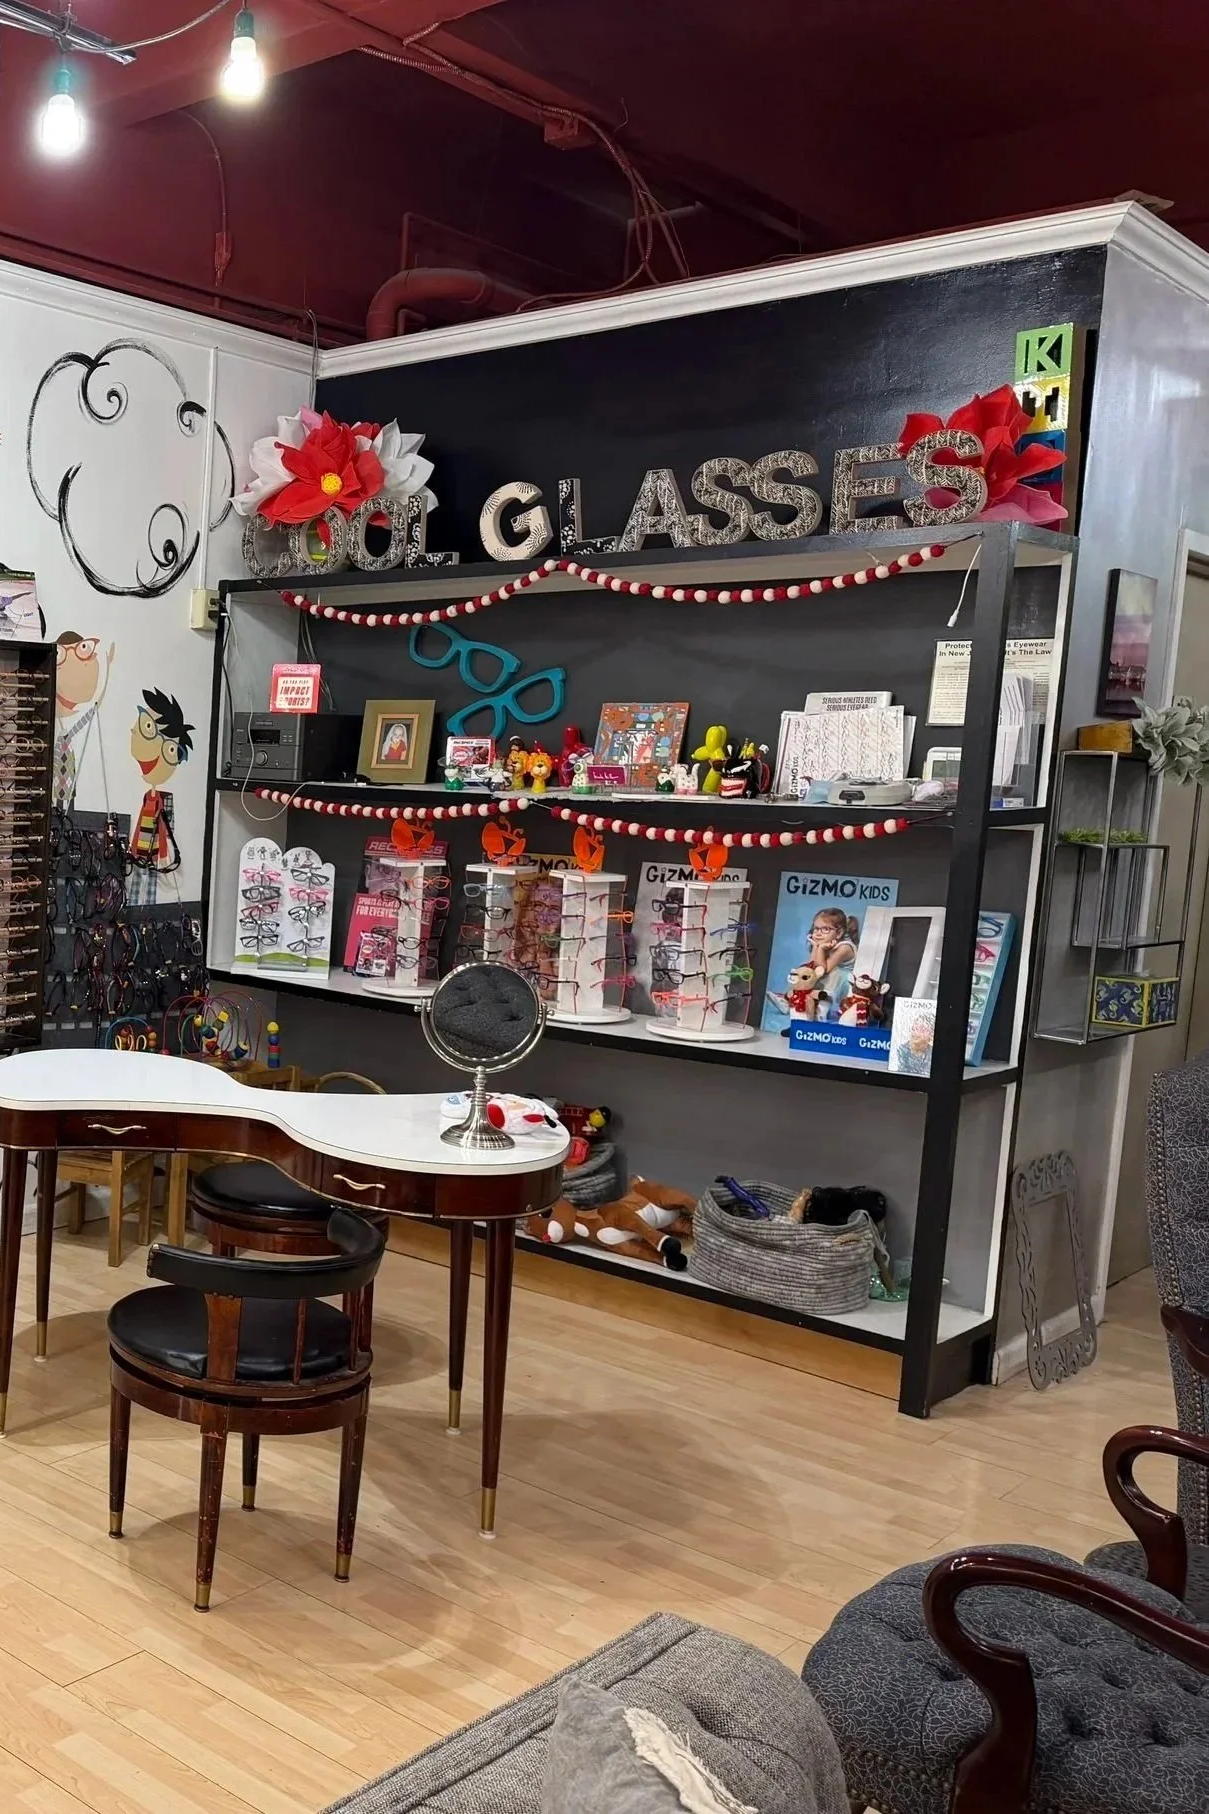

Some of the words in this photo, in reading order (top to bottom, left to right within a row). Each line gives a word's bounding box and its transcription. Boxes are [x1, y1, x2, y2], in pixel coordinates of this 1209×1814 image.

[242, 495, 459, 578] COOL
[480, 430, 988, 561] GLASSES
[280, 686, 310, 695] IMPACT
[859, 883, 891, 902] KIDS
